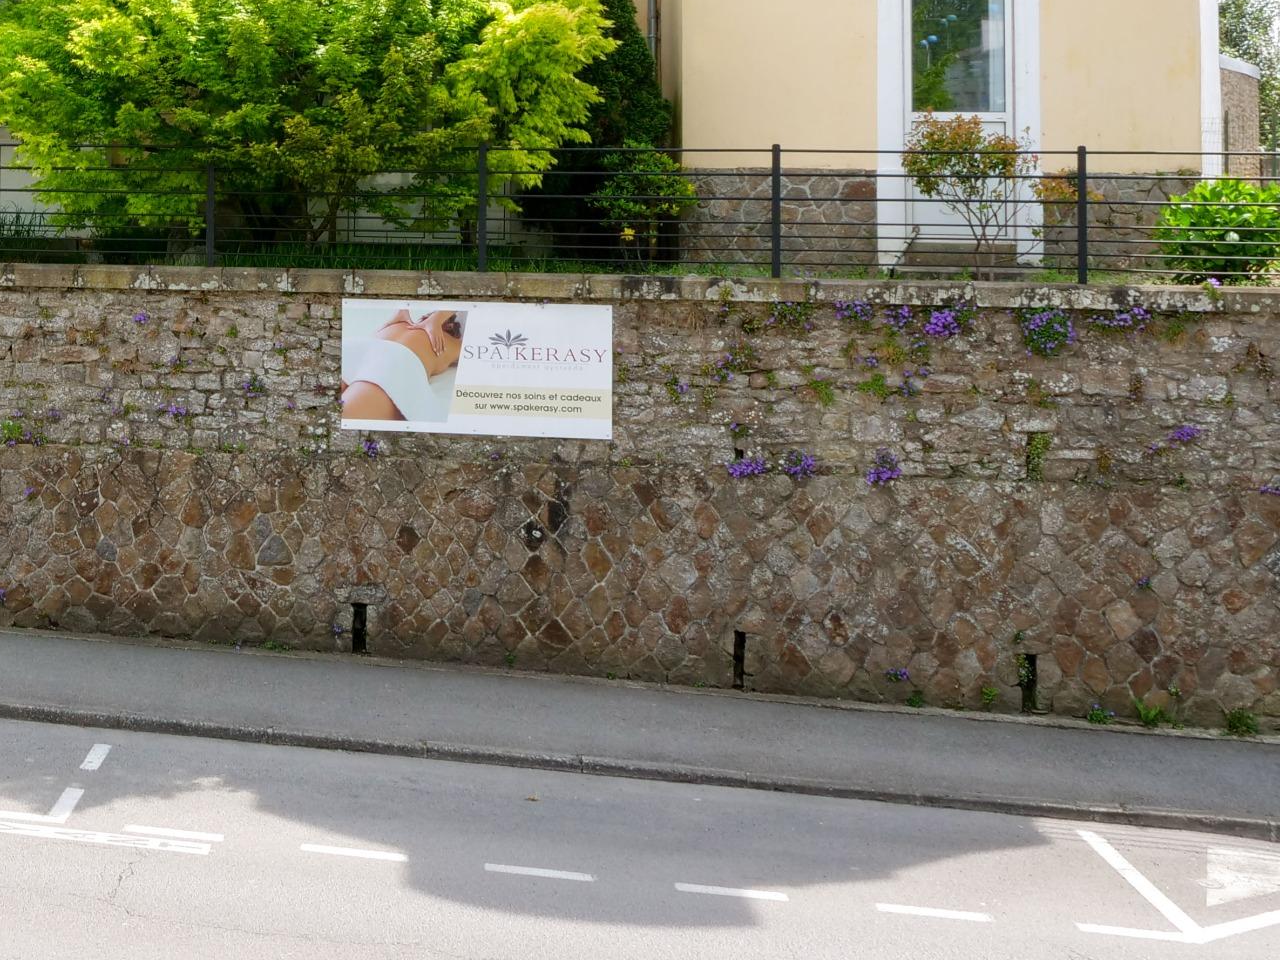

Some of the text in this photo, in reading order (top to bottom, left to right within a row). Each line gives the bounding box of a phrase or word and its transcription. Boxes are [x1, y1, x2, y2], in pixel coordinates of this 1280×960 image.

[463, 345, 608, 363] SPA KERASY
[505, 392, 522, 400] nos
[524, 392, 546, 401] soins
[548, 393, 558, 402] et
[560, 393, 602, 403] cadeaux
[474, 402, 583, 414] sur www.spakerasy.com
